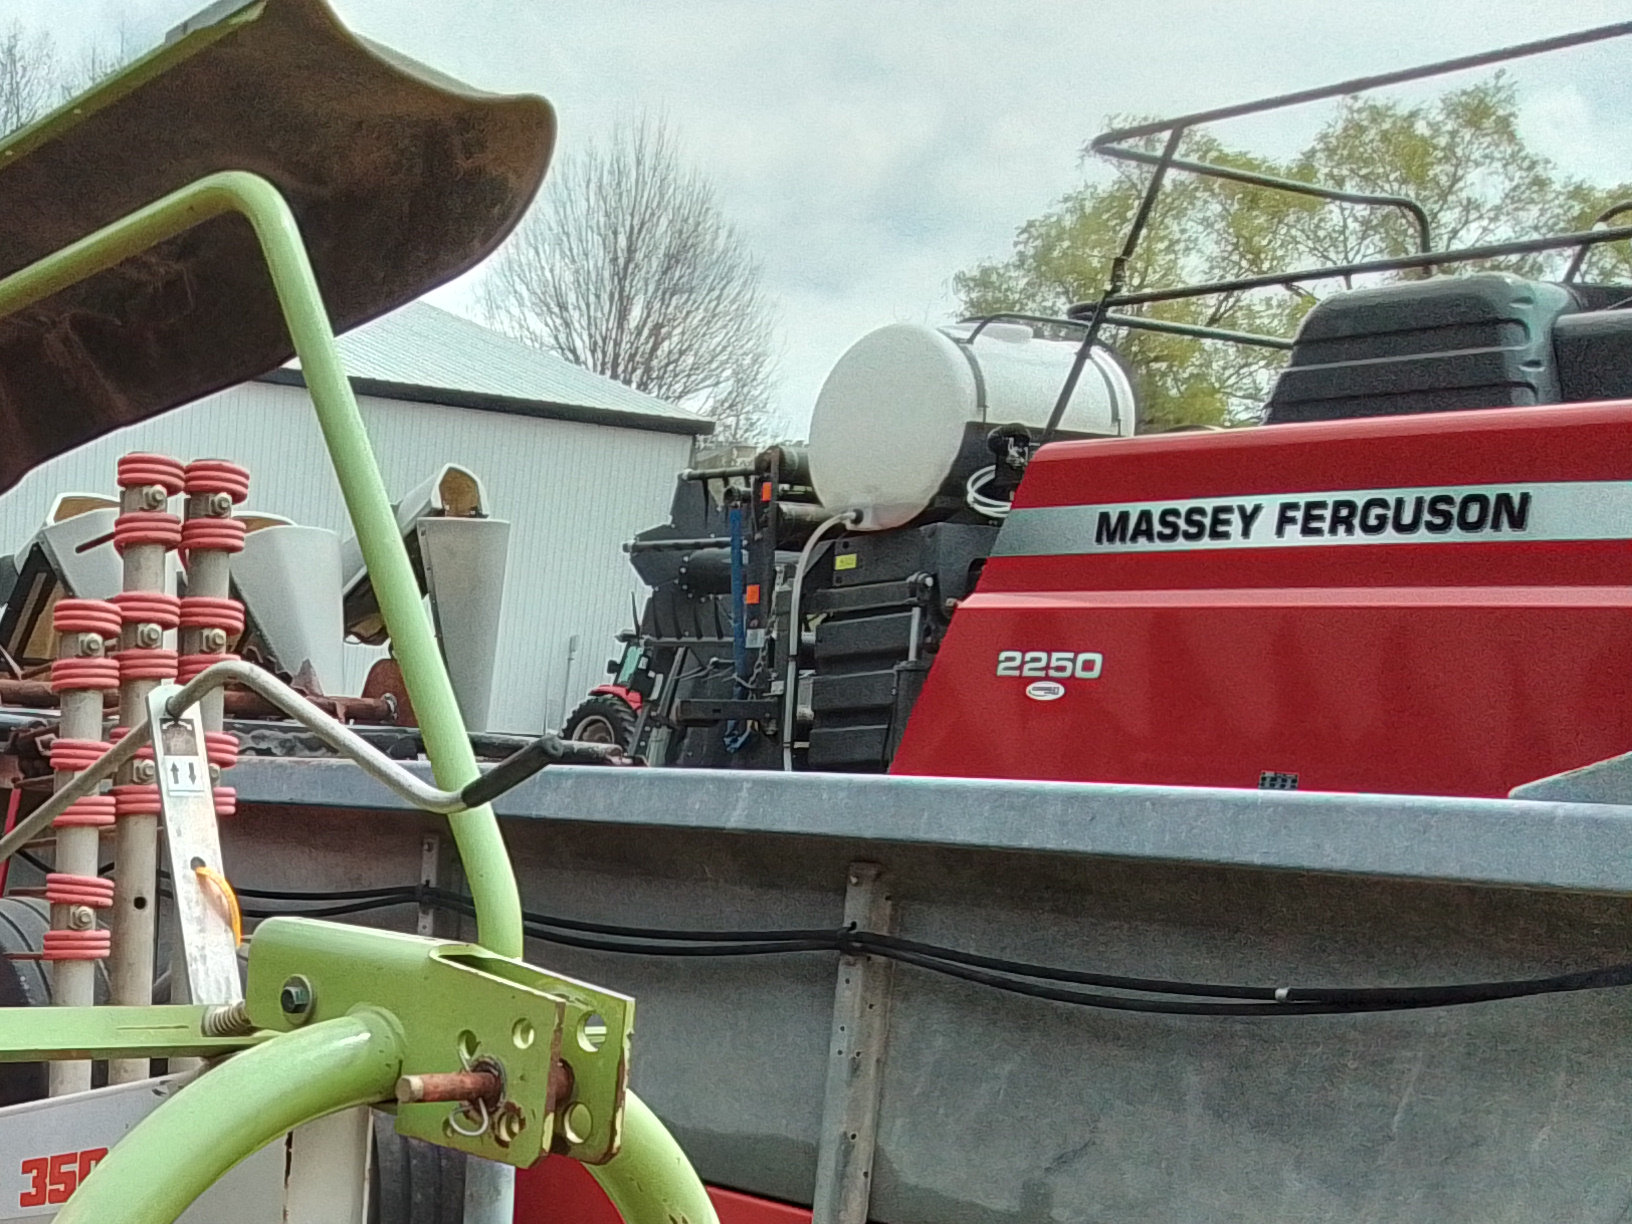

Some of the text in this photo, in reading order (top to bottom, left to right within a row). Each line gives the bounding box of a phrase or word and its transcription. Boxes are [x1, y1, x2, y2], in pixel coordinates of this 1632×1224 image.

[1094, 491, 1531, 545] MASSEY FERGUSON
[996, 650, 1103, 678] 2250
